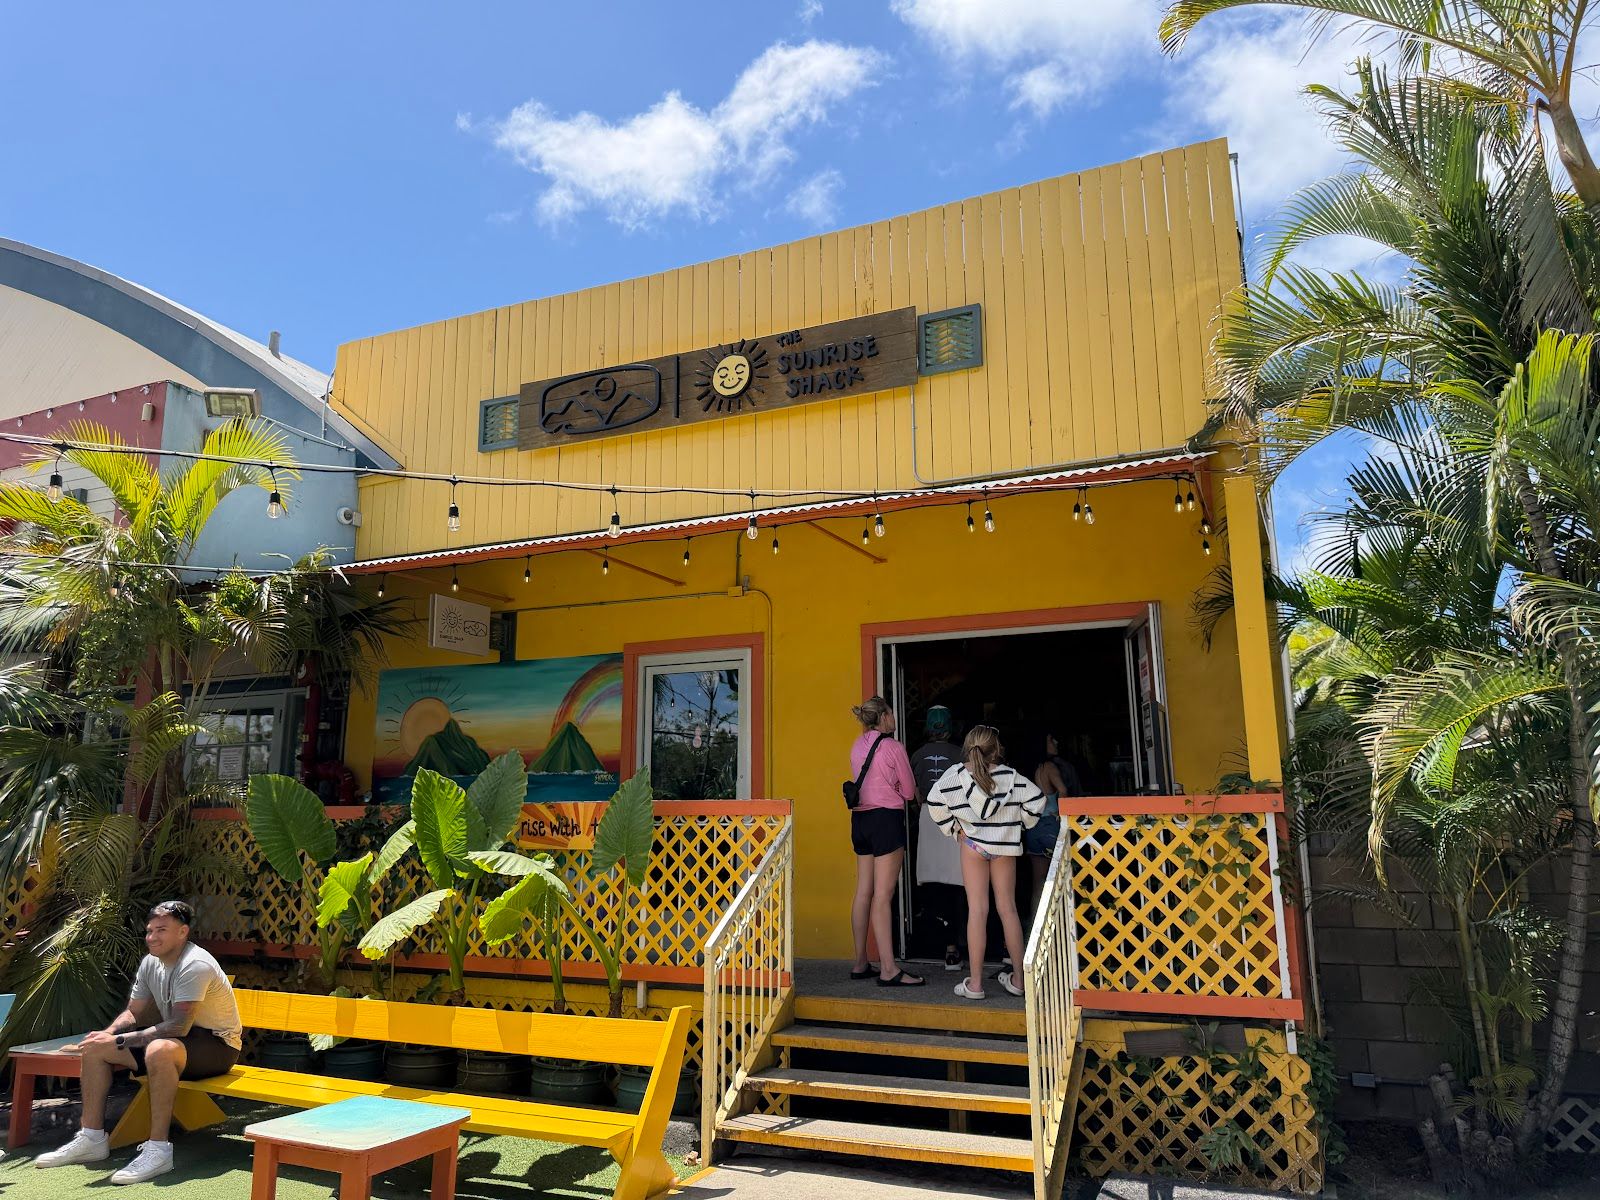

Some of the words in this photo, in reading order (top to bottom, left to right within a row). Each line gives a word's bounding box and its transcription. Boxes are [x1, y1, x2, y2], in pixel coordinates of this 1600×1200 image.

[776, 329, 802, 348] THE
[777, 335, 880, 375] SUNRISE
[785, 365, 865, 398] SHACK
[520, 818, 546, 837] rise
[550, 817, 582, 837] with
